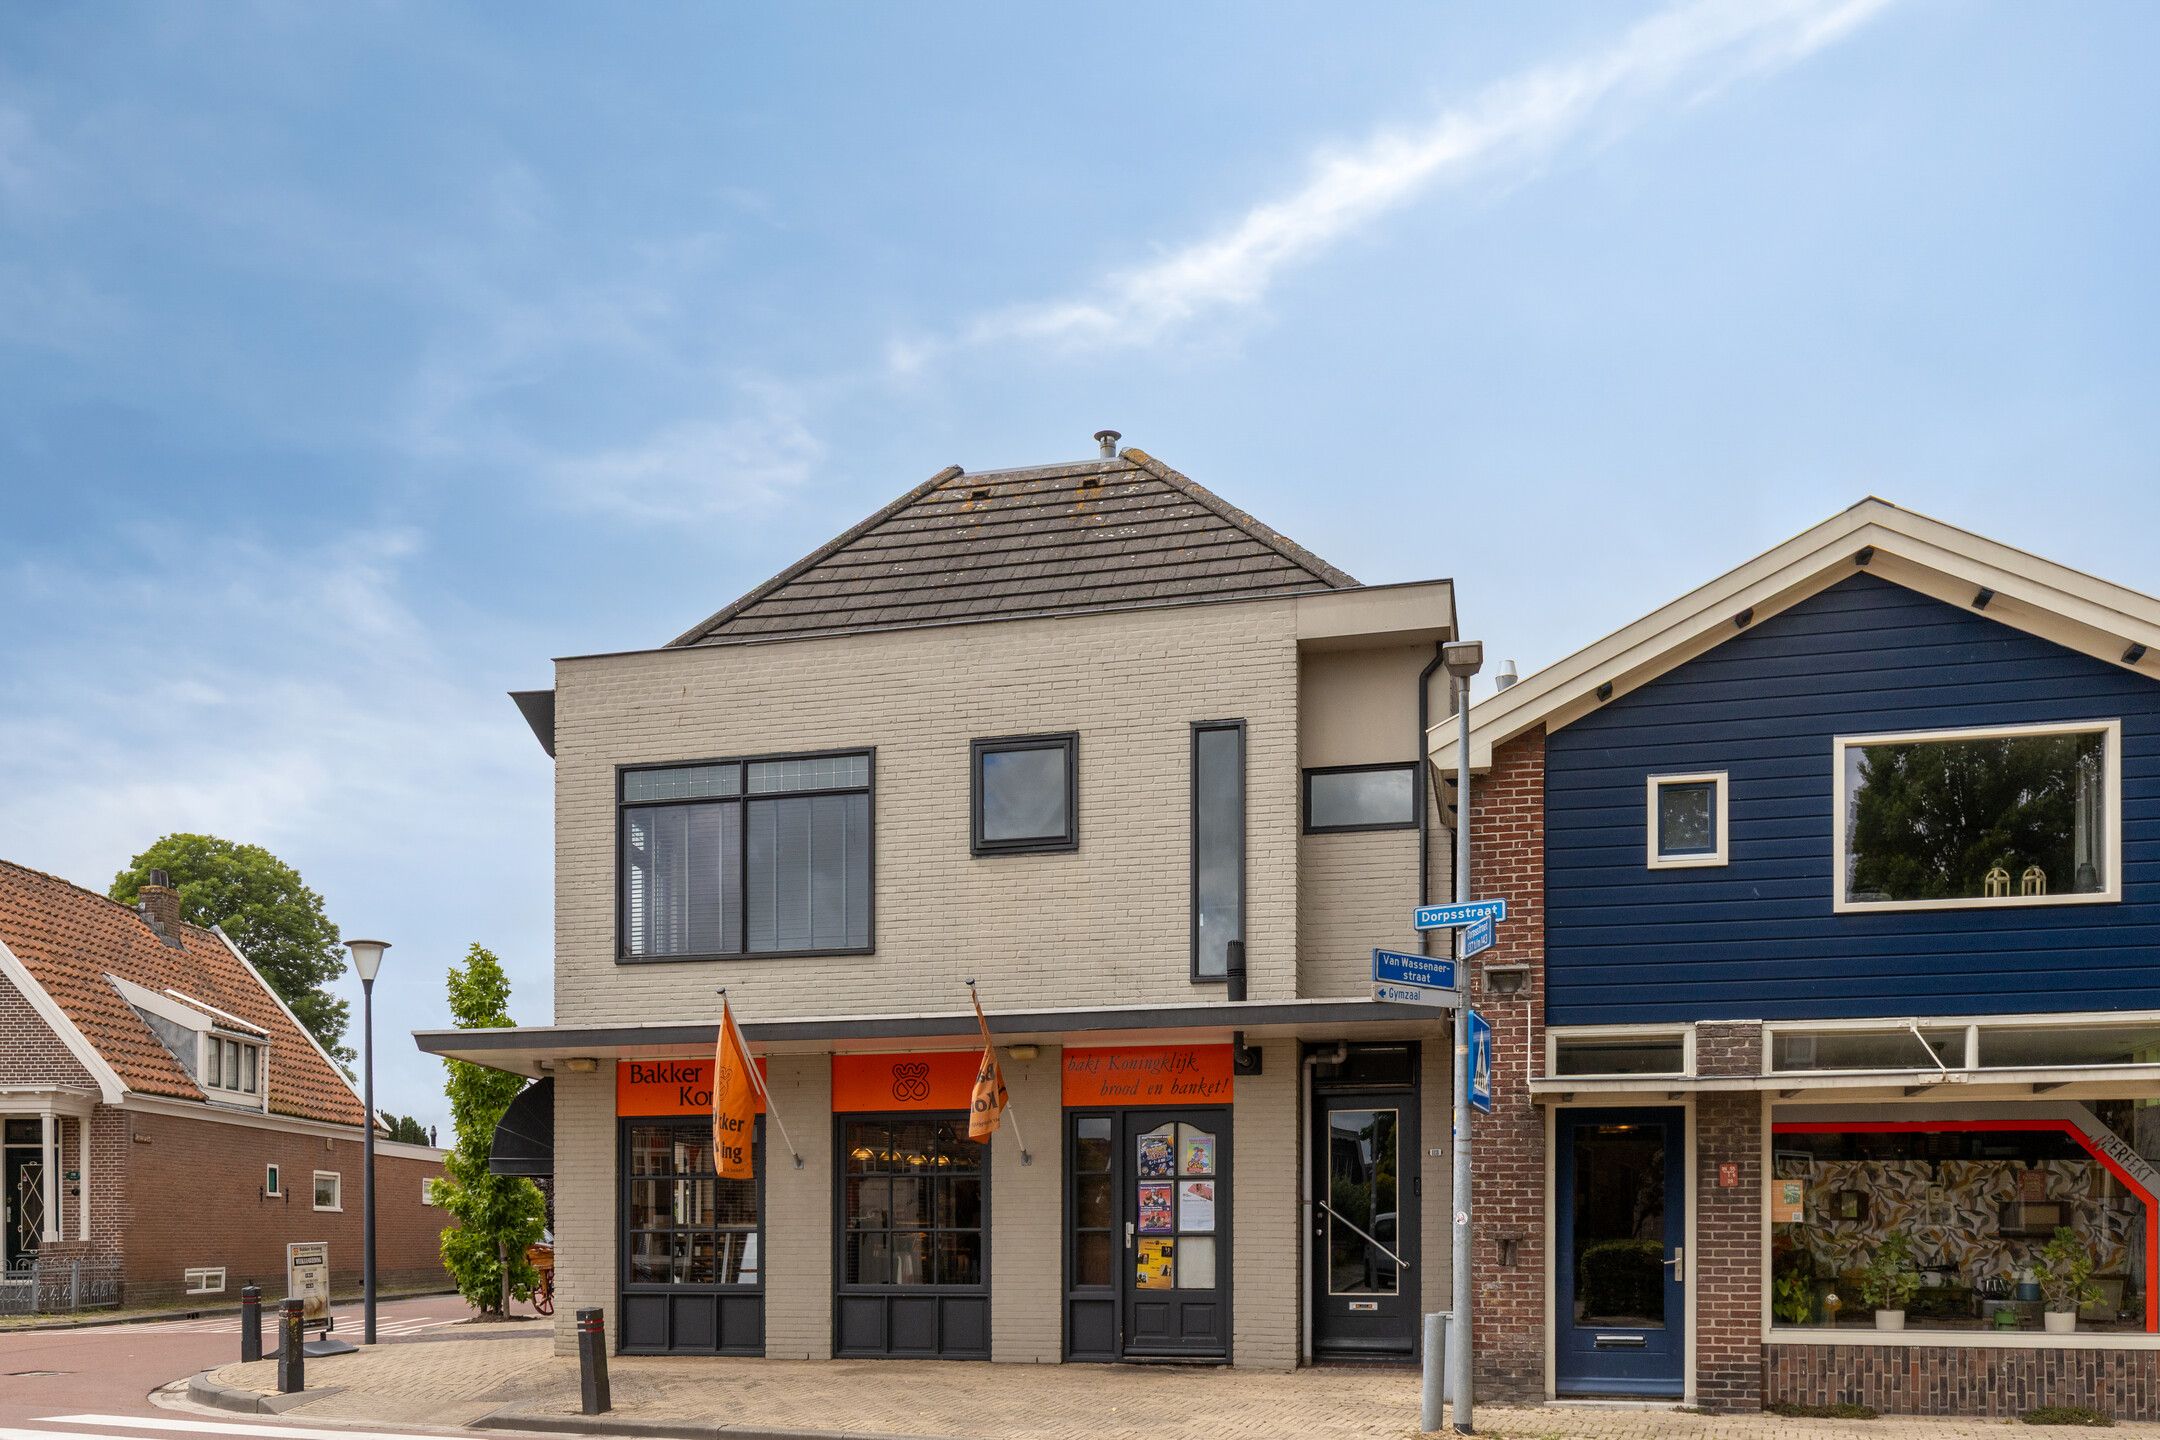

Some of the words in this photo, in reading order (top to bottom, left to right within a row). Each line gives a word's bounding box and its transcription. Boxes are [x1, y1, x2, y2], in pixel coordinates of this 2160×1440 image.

[1421, 904, 1498, 923] Dorpsstraat
[1382, 954, 1400, 967] Van
[1401, 957, 1451, 974] Wassenaer-
[1402, 971, 1431, 984] straat
[1388, 987, 1421, 1002] Gymzaal
[630, 1063, 703, 1084] Bakker
[1068, 1054, 1101, 1075] bakt
[1101, 1079, 1141, 1097] brood
[1147, 1084, 1163, 1096] en
[1171, 1077, 1229, 1098] banket!
